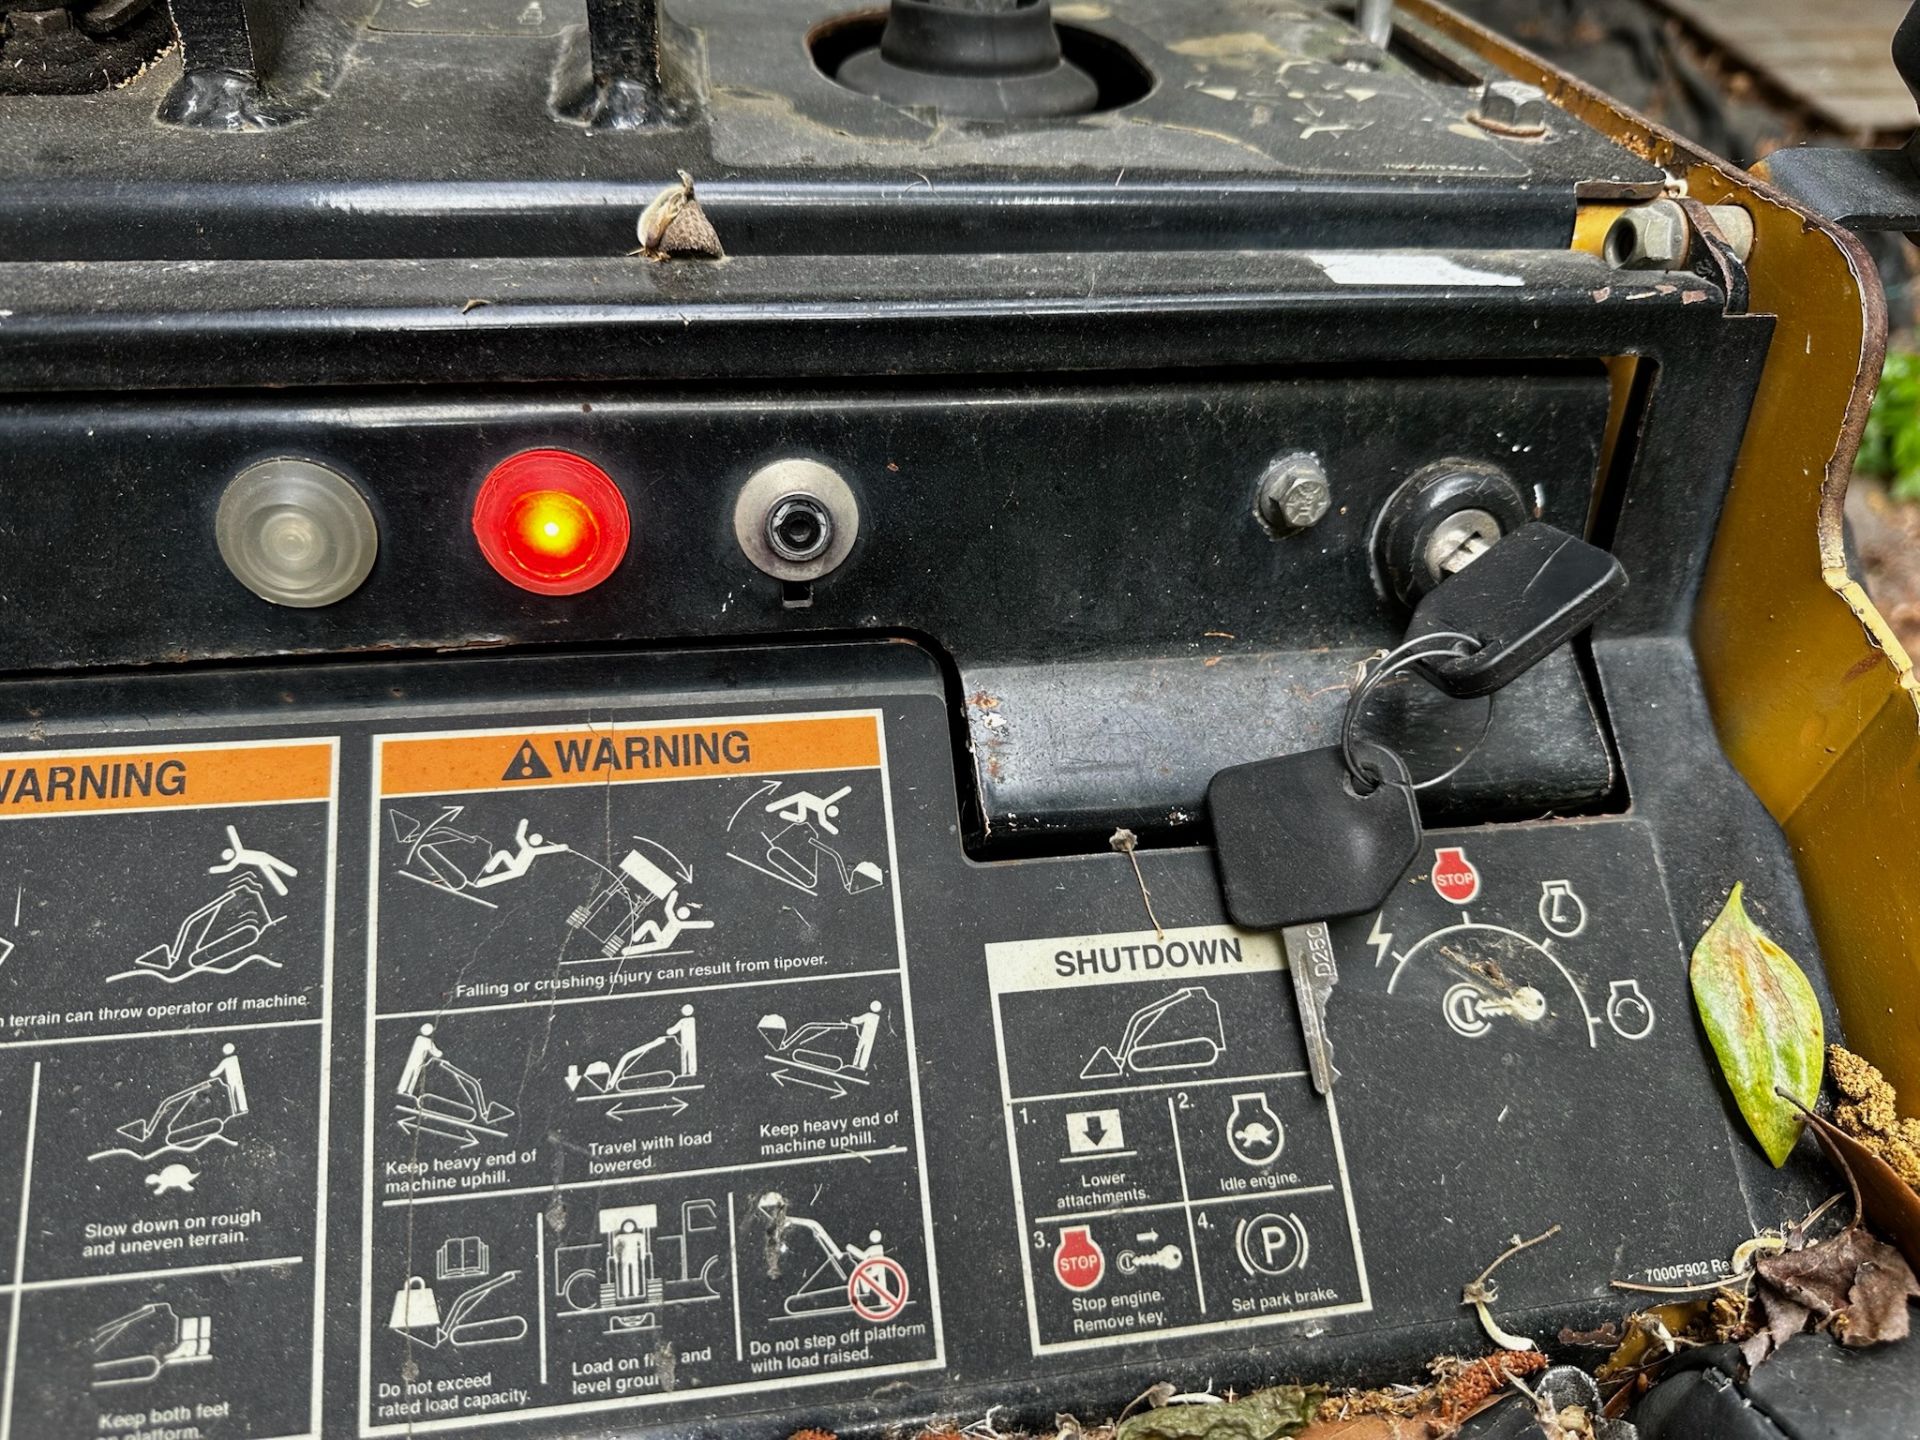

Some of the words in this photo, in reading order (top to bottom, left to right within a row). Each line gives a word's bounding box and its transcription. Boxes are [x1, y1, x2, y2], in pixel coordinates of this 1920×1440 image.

[554, 730, 750, 773] WARNING
[1436, 872, 1473, 887] STOP
[1054, 937, 1243, 977] SHUTDOWN
[456, 982, 509, 999] Falling
[514, 980, 531, 993] or
[534, 973, 605, 992] crushing
[609, 969, 653, 987] injury
[657, 966, 684, 980] can
[689, 961, 731, 976] result
[735, 959, 769, 973] from
[773, 955, 828, 973] tipover.
[10, 1011, 60, 1027] terrain
[65, 1011, 94, 1024] can
[99, 1006, 142, 1021] throw
[147, 1001, 213, 1018] operator
[217, 997, 238, 1012] off
[1177, 1092, 1195, 1109] 2.
[760, 1124, 799, 1142] Keep
[803, 1118, 847, 1133] heavy
[852, 1112, 880, 1128] end
[884, 1110, 899, 1124] of
[1019, 1107, 1037, 1124] 1.
[589, 1138, 637, 1156] Travel
[641, 1136, 675, 1151] with
[679, 1132, 712, 1146] load
[761, 1137, 826, 1155] machine
[830, 1131, 877, 1149] uphill.
[385, 1161, 427, 1179] Keep
[434, 1156, 481, 1174] heavy
[486, 1151, 516, 1166] end
[521, 1148, 537, 1162] of
[384, 1176, 457, 1194] machine
[461, 1170, 510, 1189] uphill.
[1081, 1172, 1126, 1187] Lower
[1220, 1176, 1247, 1192] Idle
[1250, 1172, 1301, 1189] engine.
[1056, 1187, 1150, 1209] attachments.
[85, 1223, 127, 1238] Slow
[132, 1219, 179, 1235] down
[184, 1217, 206, 1229] on
[211, 1209, 261, 1227] rough
[1197, 1212, 1215, 1230] 4.
[83, 1241, 115, 1258] and
[121, 1237, 184, 1254] uneven
[189, 1229, 249, 1247] terrain.
[1033, 1231, 1051, 1249] 3.
[1261, 1226, 1286, 1265] P
[1060, 1254, 1098, 1271] STOP
[1646, 1261, 1708, 1282] 7000F902
[1071, 1297, 1107, 1313] Stop
[1111, 1290, 1165, 1308] engine.
[1232, 1297, 1255, 1312] Set
[1260, 1292, 1291, 1311] park
[1073, 1316, 1134, 1334] Remove
[1138, 1311, 1167, 1327] key.
[750, 1340, 771, 1355] Do
[775, 1337, 800, 1352] not
[804, 1333, 836, 1349] step
[840, 1329, 860, 1344] off
[864, 1323, 926, 1343] platform
[572, 1358, 613, 1376] Load
[618, 1356, 639, 1371] on
[681, 1346, 712, 1364] and
[751, 1358, 783, 1374] with
[786, 1353, 819, 1369] load
[824, 1347, 873, 1365] raised.
[379, 1383, 400, 1398] Do
[407, 1379, 433, 1396] not
[436, 1372, 492, 1392] exceed
[572, 1377, 611, 1395] level
[378, 1400, 421, 1417] rated
[425, 1395, 459, 1413] load
[463, 1389, 531, 1409] capacity.
[98, 1413, 147, 1430] Keep
[150, 1405, 191, 1423] both
[196, 1401, 231, 1418] feet
